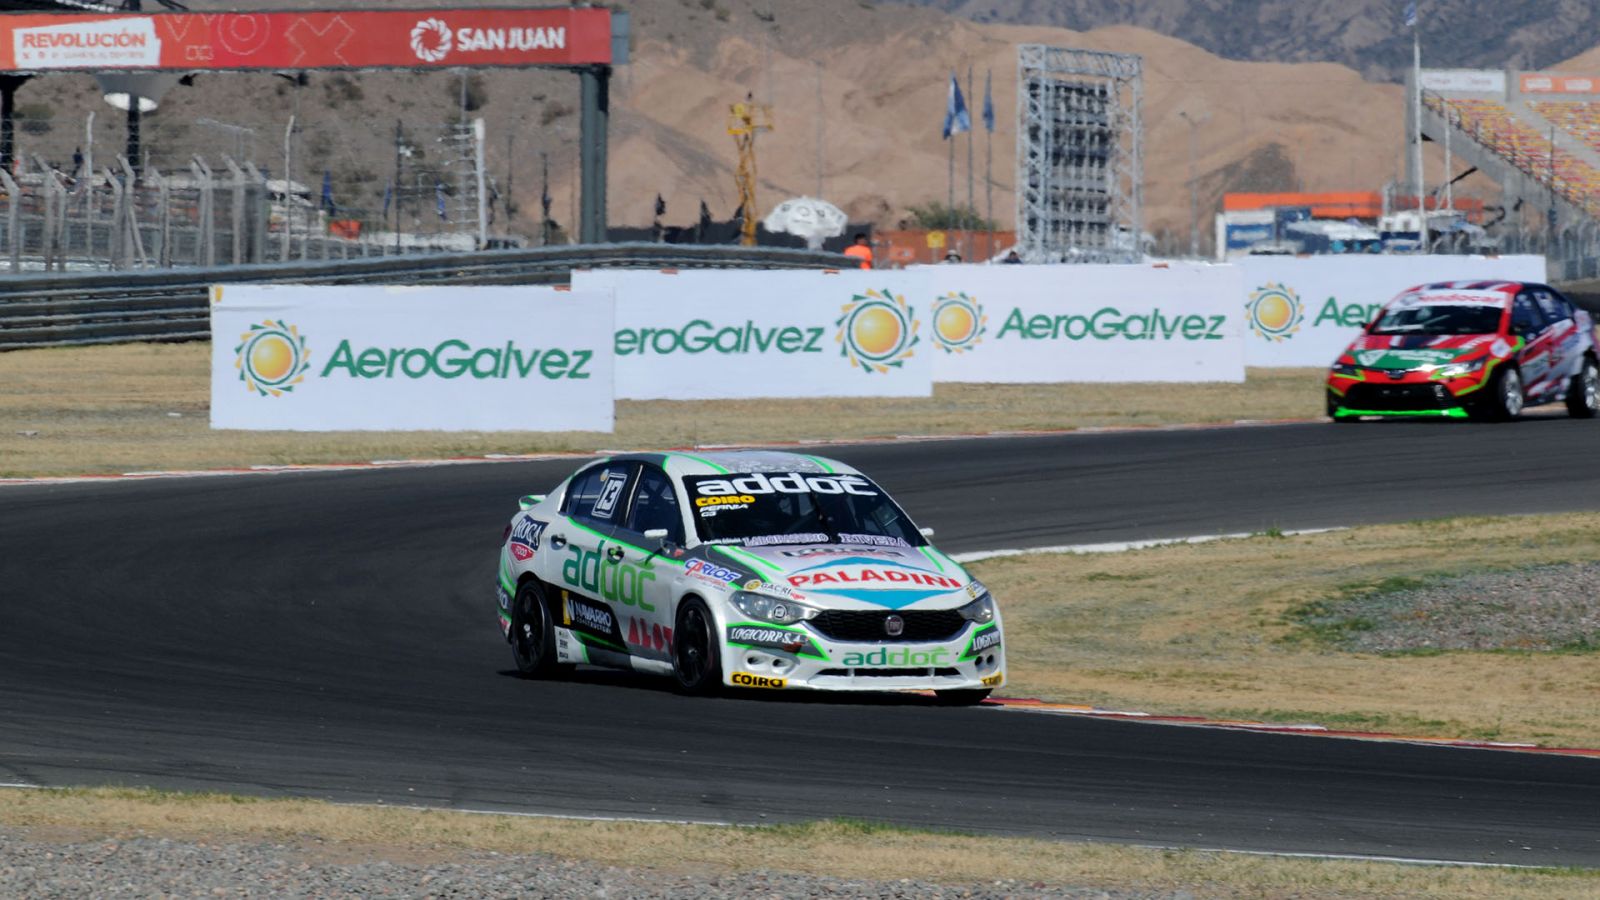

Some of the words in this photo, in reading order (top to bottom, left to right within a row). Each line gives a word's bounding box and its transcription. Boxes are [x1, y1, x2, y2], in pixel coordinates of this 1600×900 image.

[22, 29, 147, 48] REVOLUCIÓN
[456, 28, 505, 51] SAN
[508, 27, 565, 50] JUAN
[1313, 296, 1381, 326] Aer
[996, 307, 1226, 340] AeroGalvez
[614, 319, 824, 355] eroGalvez
[320, 339, 592, 379] AeroGalvez
[696, 495, 755, 506] COIRO
[838, 533, 909, 547] RIVERA
[685, 559, 742, 582] CARLOS
[787, 570, 962, 588] PALADINI
[575, 601, 612, 628] NAVARRO
[731, 673, 783, 688] COIRO
